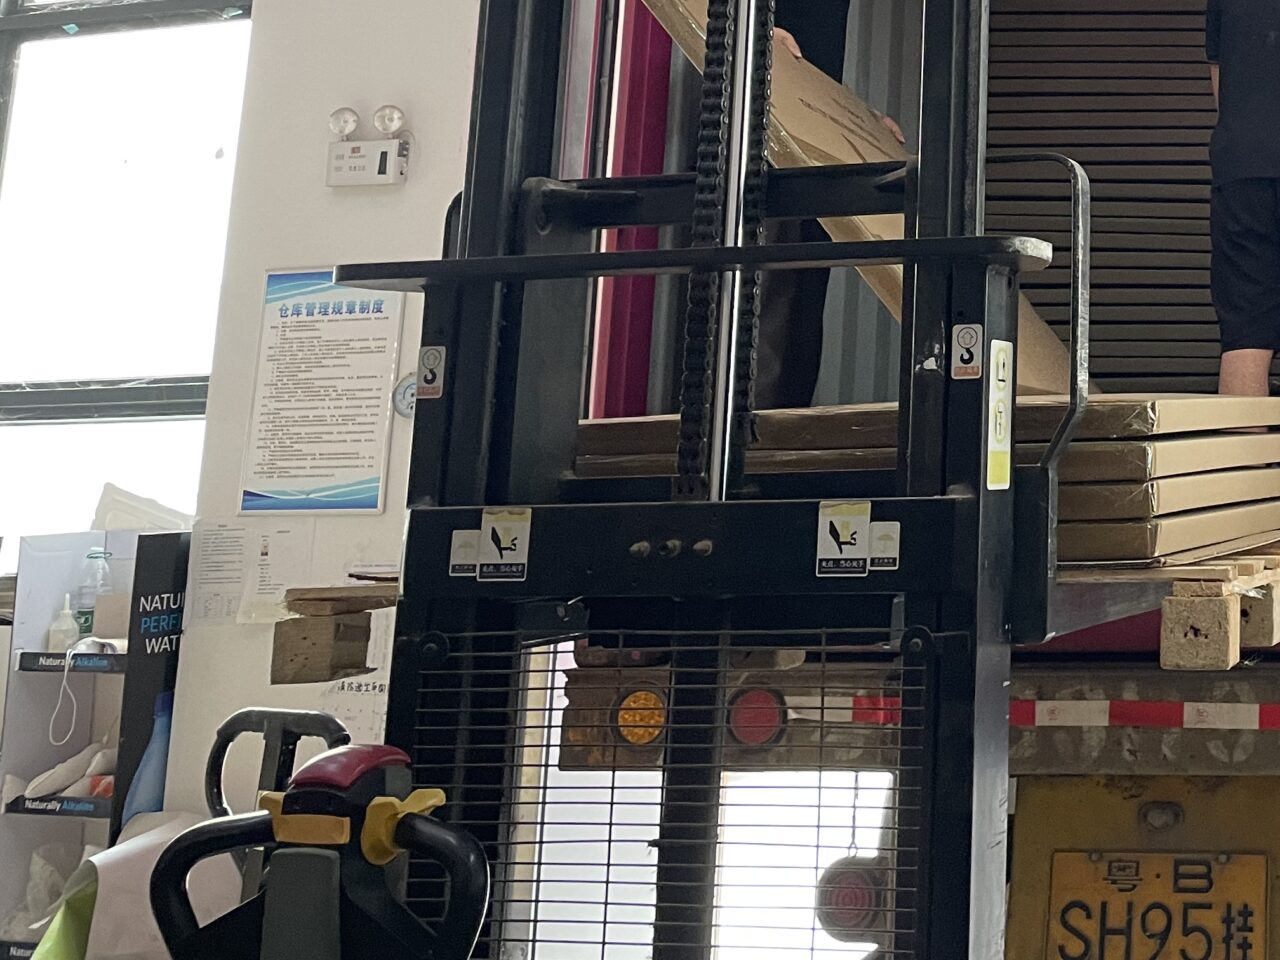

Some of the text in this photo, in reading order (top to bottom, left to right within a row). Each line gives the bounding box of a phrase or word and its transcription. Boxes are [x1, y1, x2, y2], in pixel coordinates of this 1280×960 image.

[278, 298, 385, 318] 仓库管理规章制度
[139, 591, 185, 613] NATU
[140, 613, 181, 634] PERF
[38, 656, 75, 668] Naturay
[9, 945, 35, 958] Natur
